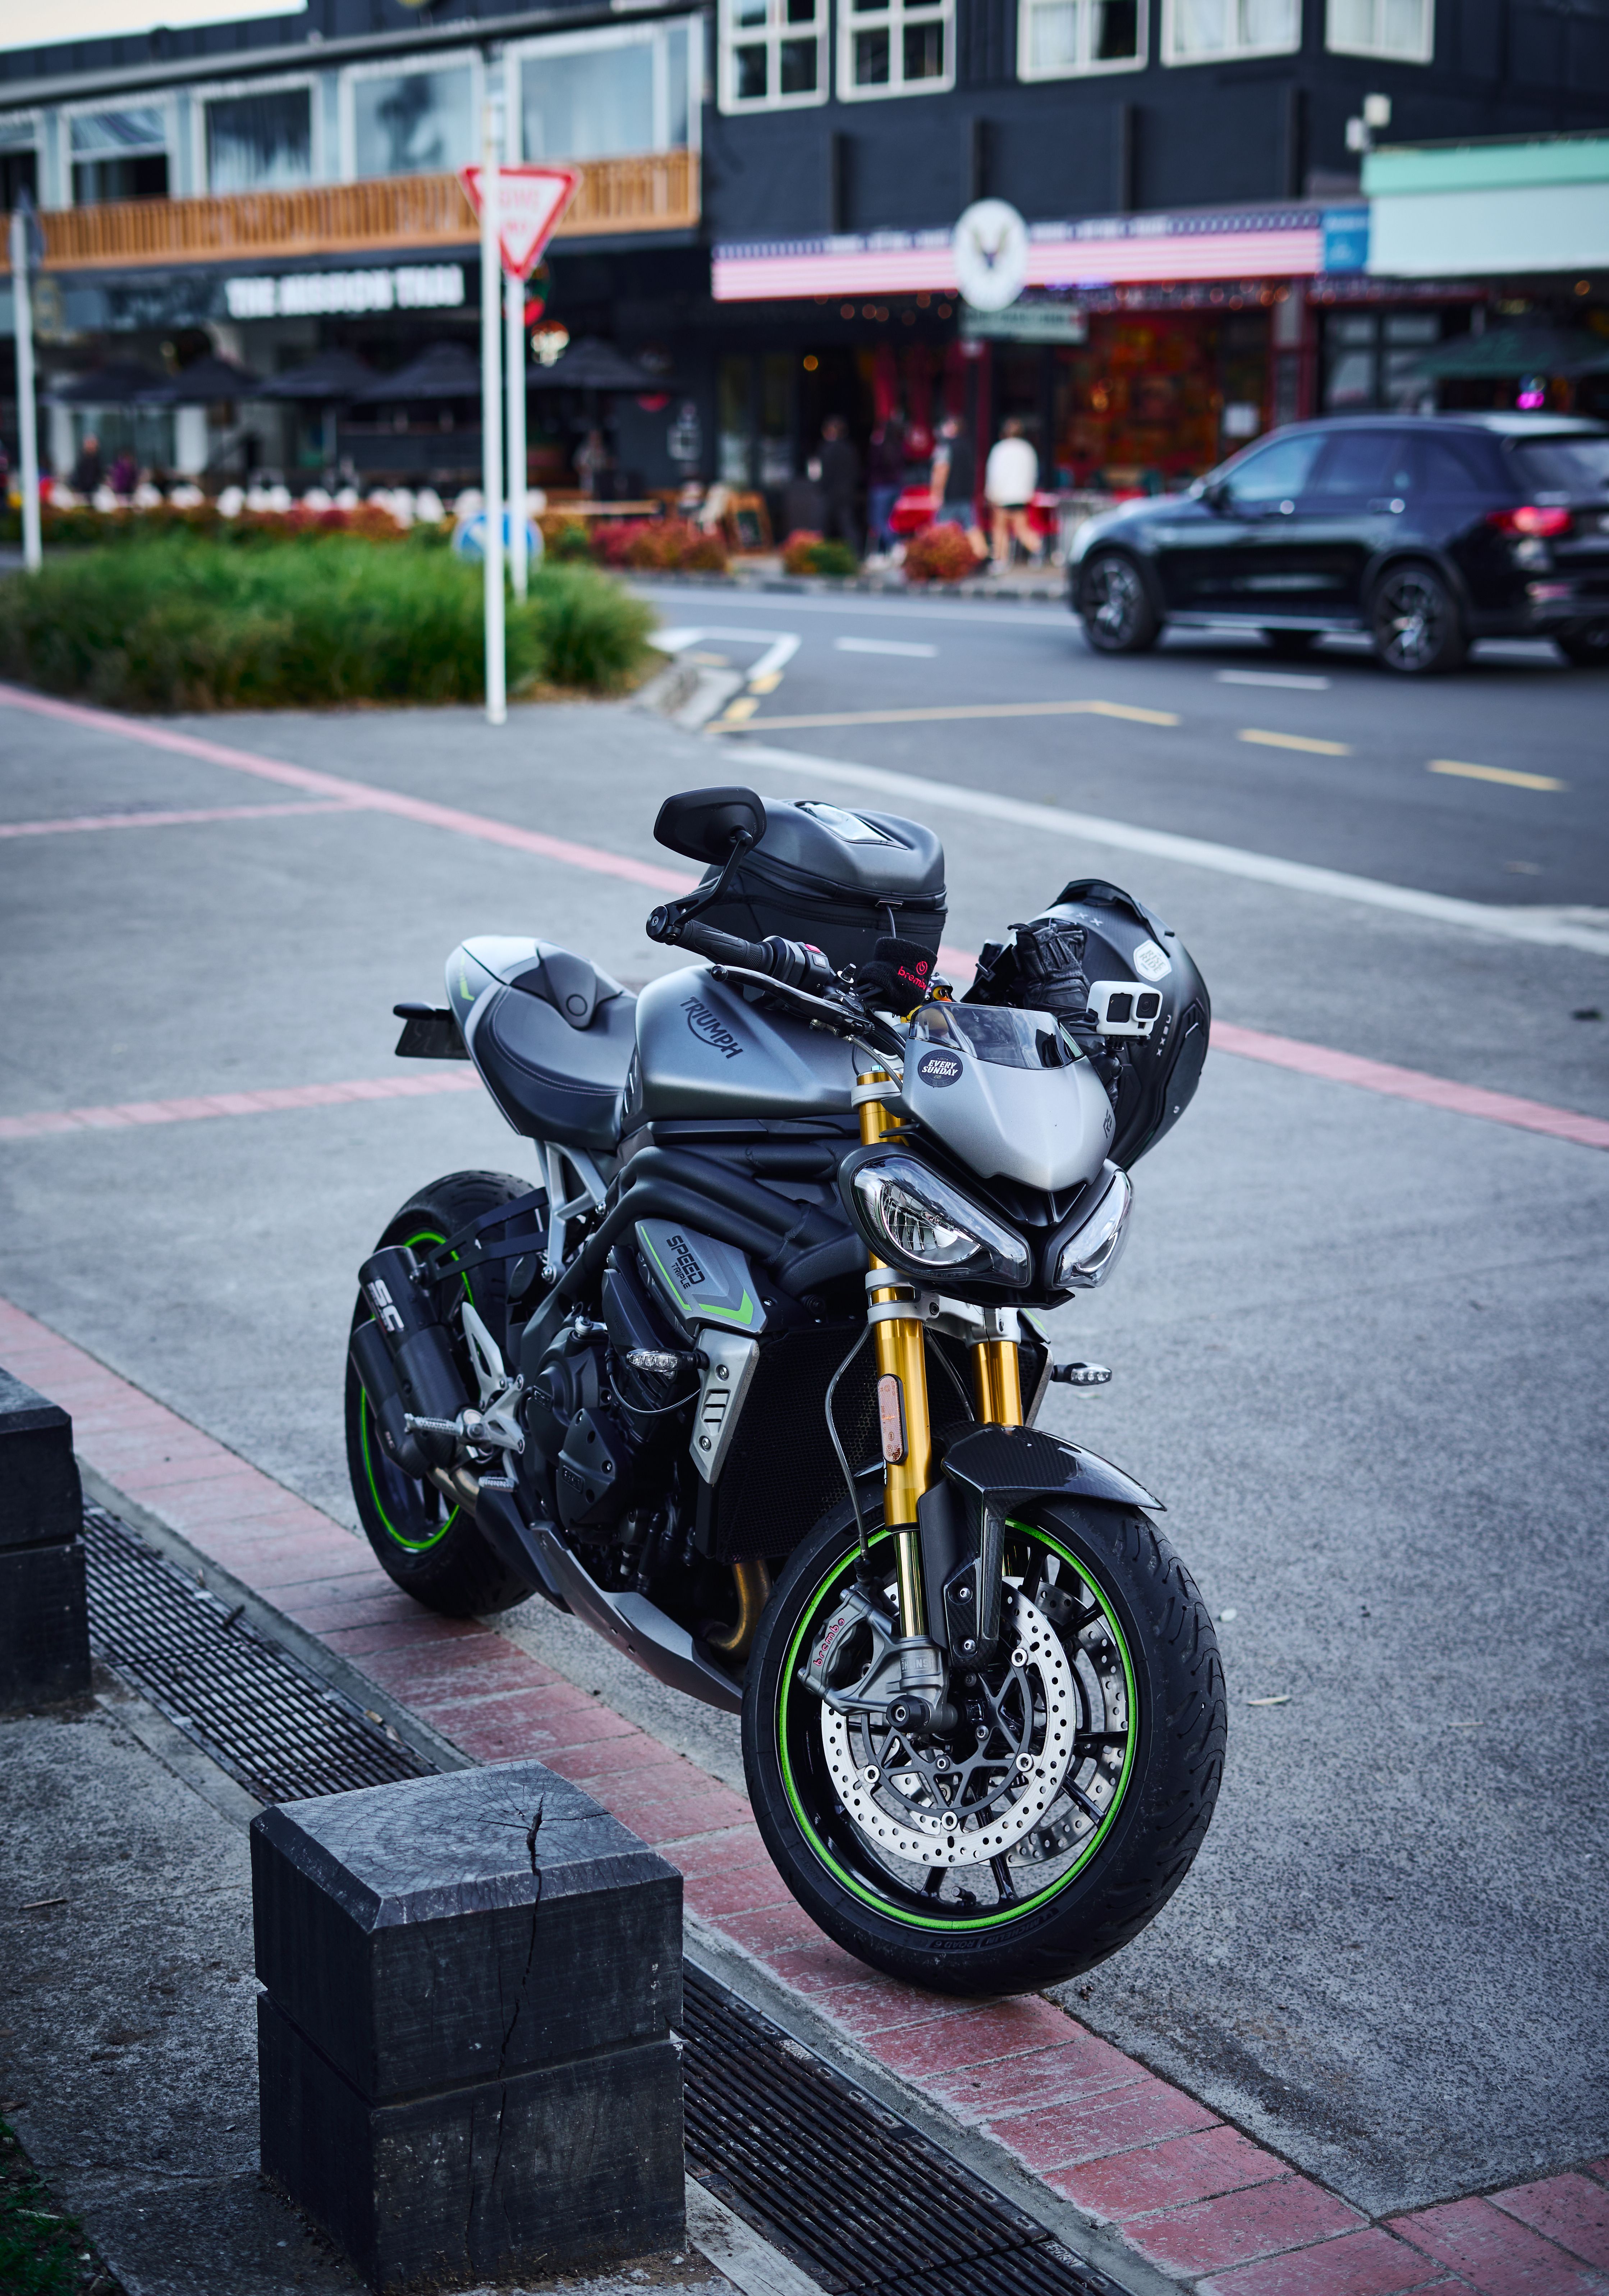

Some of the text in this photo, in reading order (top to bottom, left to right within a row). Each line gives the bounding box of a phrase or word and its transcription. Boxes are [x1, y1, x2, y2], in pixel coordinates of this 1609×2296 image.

[1139, 953, 1159, 973] RIDE
[1146, 950, 1165, 970] RISE
[680, 996, 743, 1059] TRIUMPH
[921, 1066, 958, 1076] SUNDAY
[927, 1060, 957, 1069] EVERY
[1103, 1108, 1112, 1139] RS
[666, 1235, 705, 1284] SPEED
[671, 1262, 691, 1289] TRIPLE
[814, 1618, 845, 1666] brembo
[944, 1939, 975, 1948] ROAD
[986, 1916, 1041, 1945] MICHELIN
